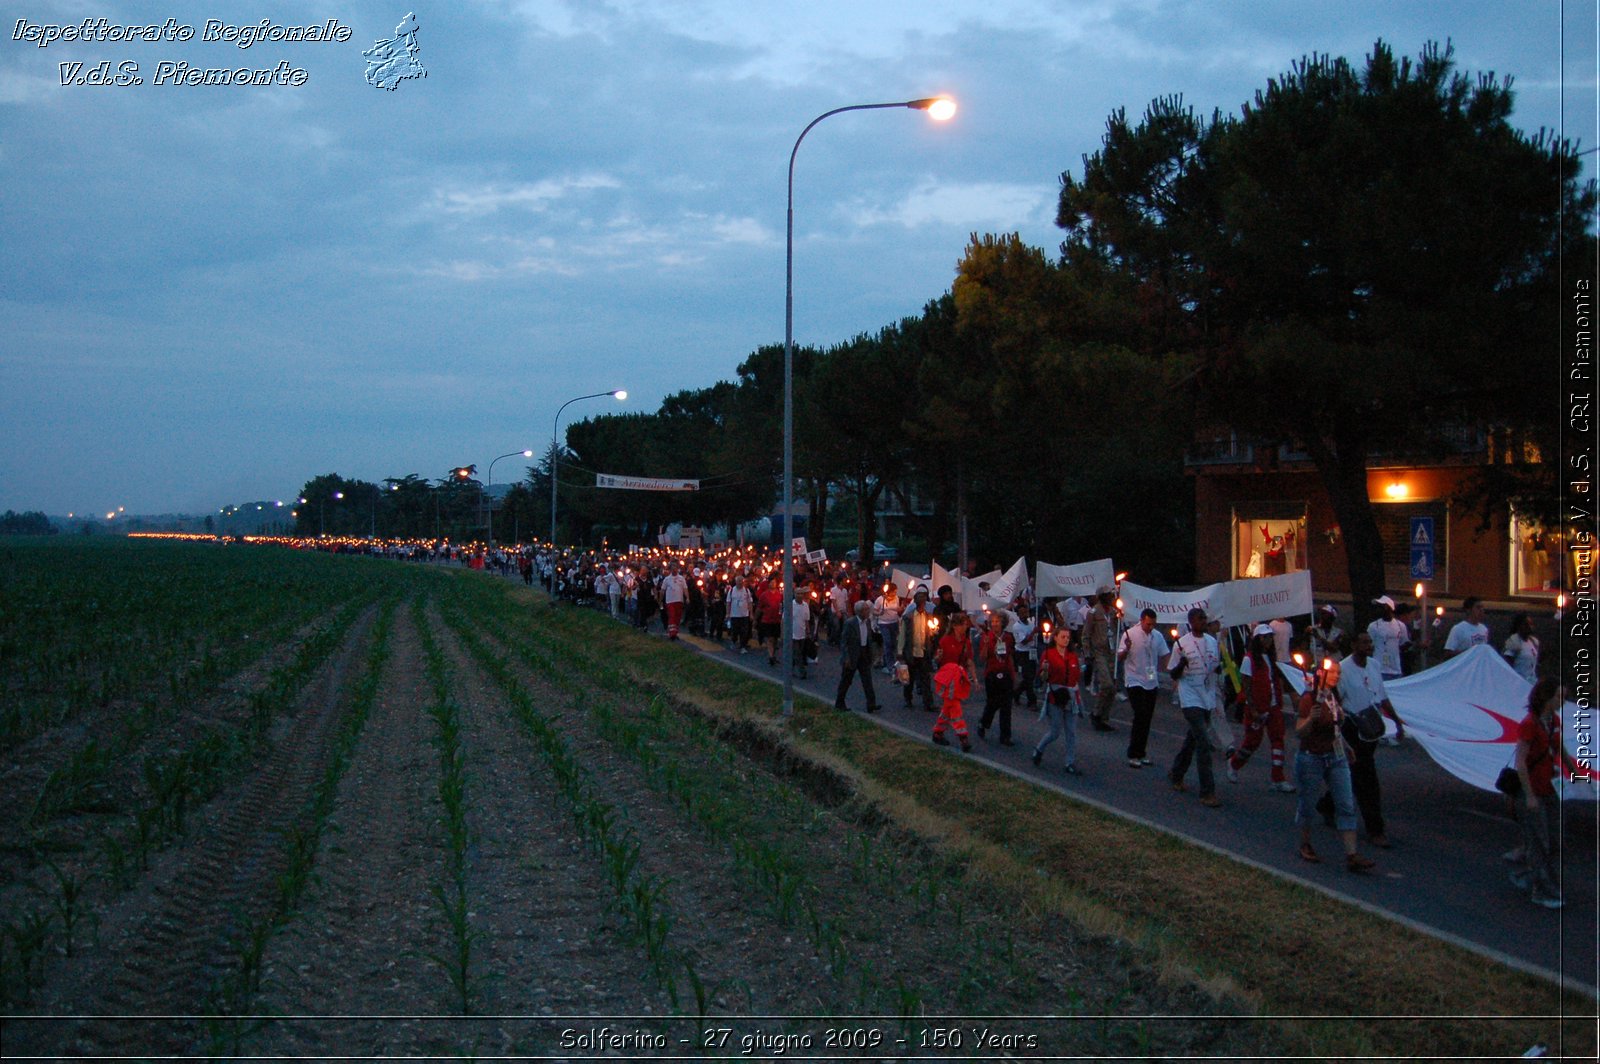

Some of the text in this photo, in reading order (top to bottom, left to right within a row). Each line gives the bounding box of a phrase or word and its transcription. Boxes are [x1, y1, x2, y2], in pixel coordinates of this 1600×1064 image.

[621, 479, 674, 490] Arrivederci
[1135, 598, 1210, 613] IMPARTIALITY
[1249, 590, 1290, 607] HUMANITY
